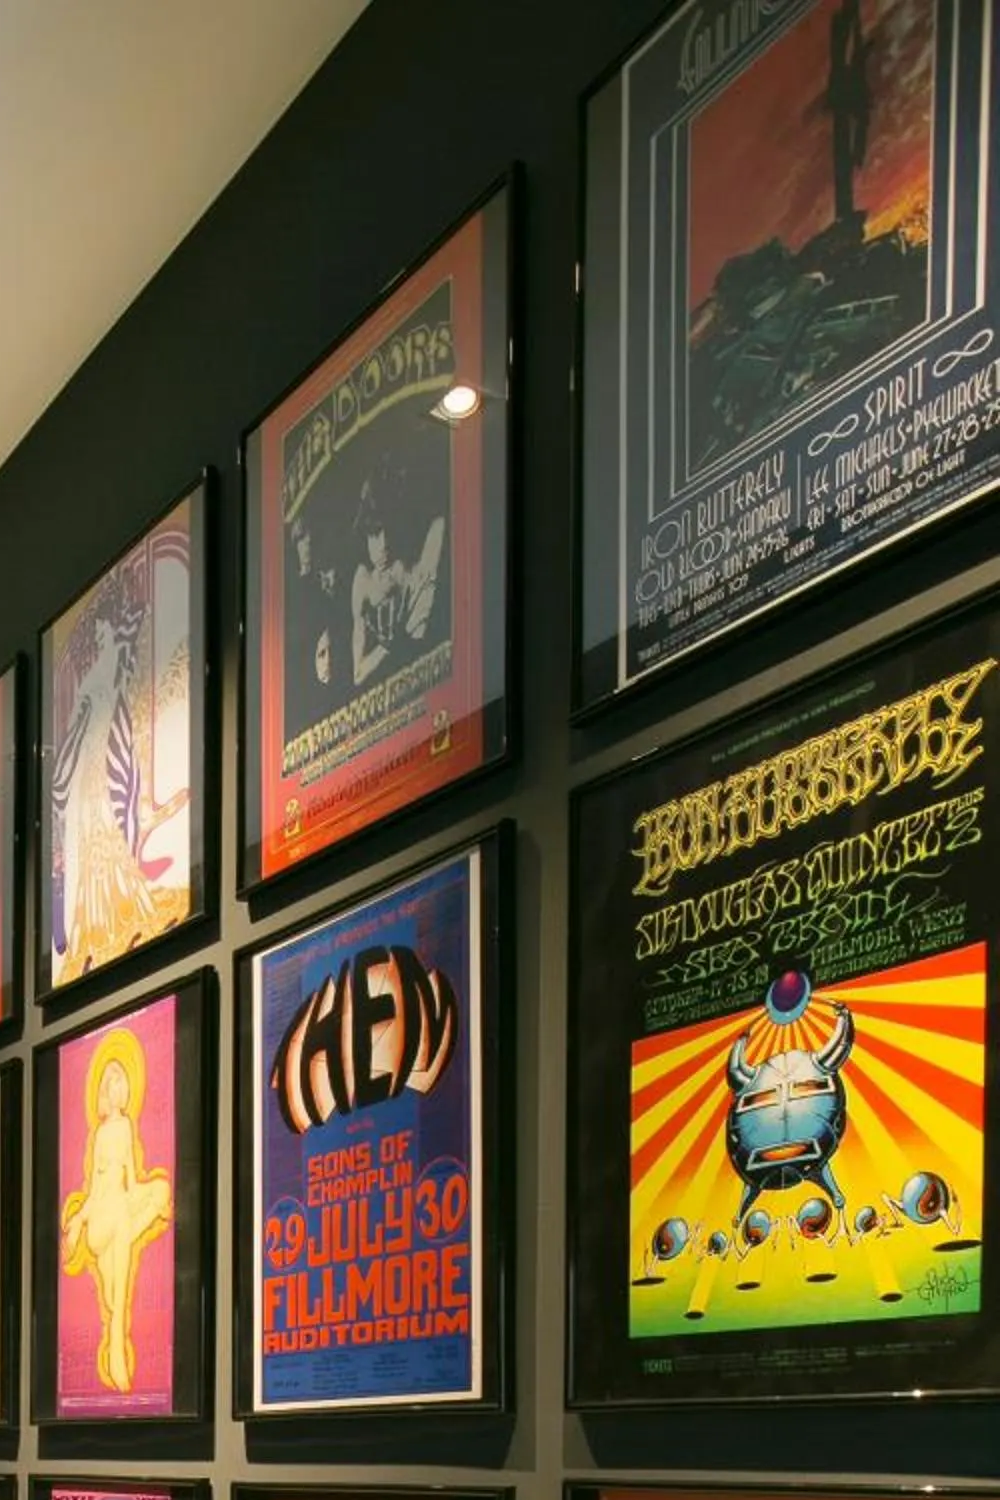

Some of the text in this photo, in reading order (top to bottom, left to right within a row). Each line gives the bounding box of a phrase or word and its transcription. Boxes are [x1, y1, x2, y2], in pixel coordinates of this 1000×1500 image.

[864, 357, 927, 433] SPIRIT
[641, 508, 692, 571] IRON
[697, 449, 786, 537] BUTTERFLY
[834, 483, 857, 519] SAT
[865, 462, 892, 500] SUN
[269, 944, 459, 1135] THEM
[306, 1160, 413, 1207] CHAMPLIN
[307, 1128, 414, 1183] SONS OF
[266, 1174, 469, 1269] 29 JULY 30
[263, 1241, 469, 1331] FILLMORE
[263, 1307, 470, 1355] AUDITORIUM
